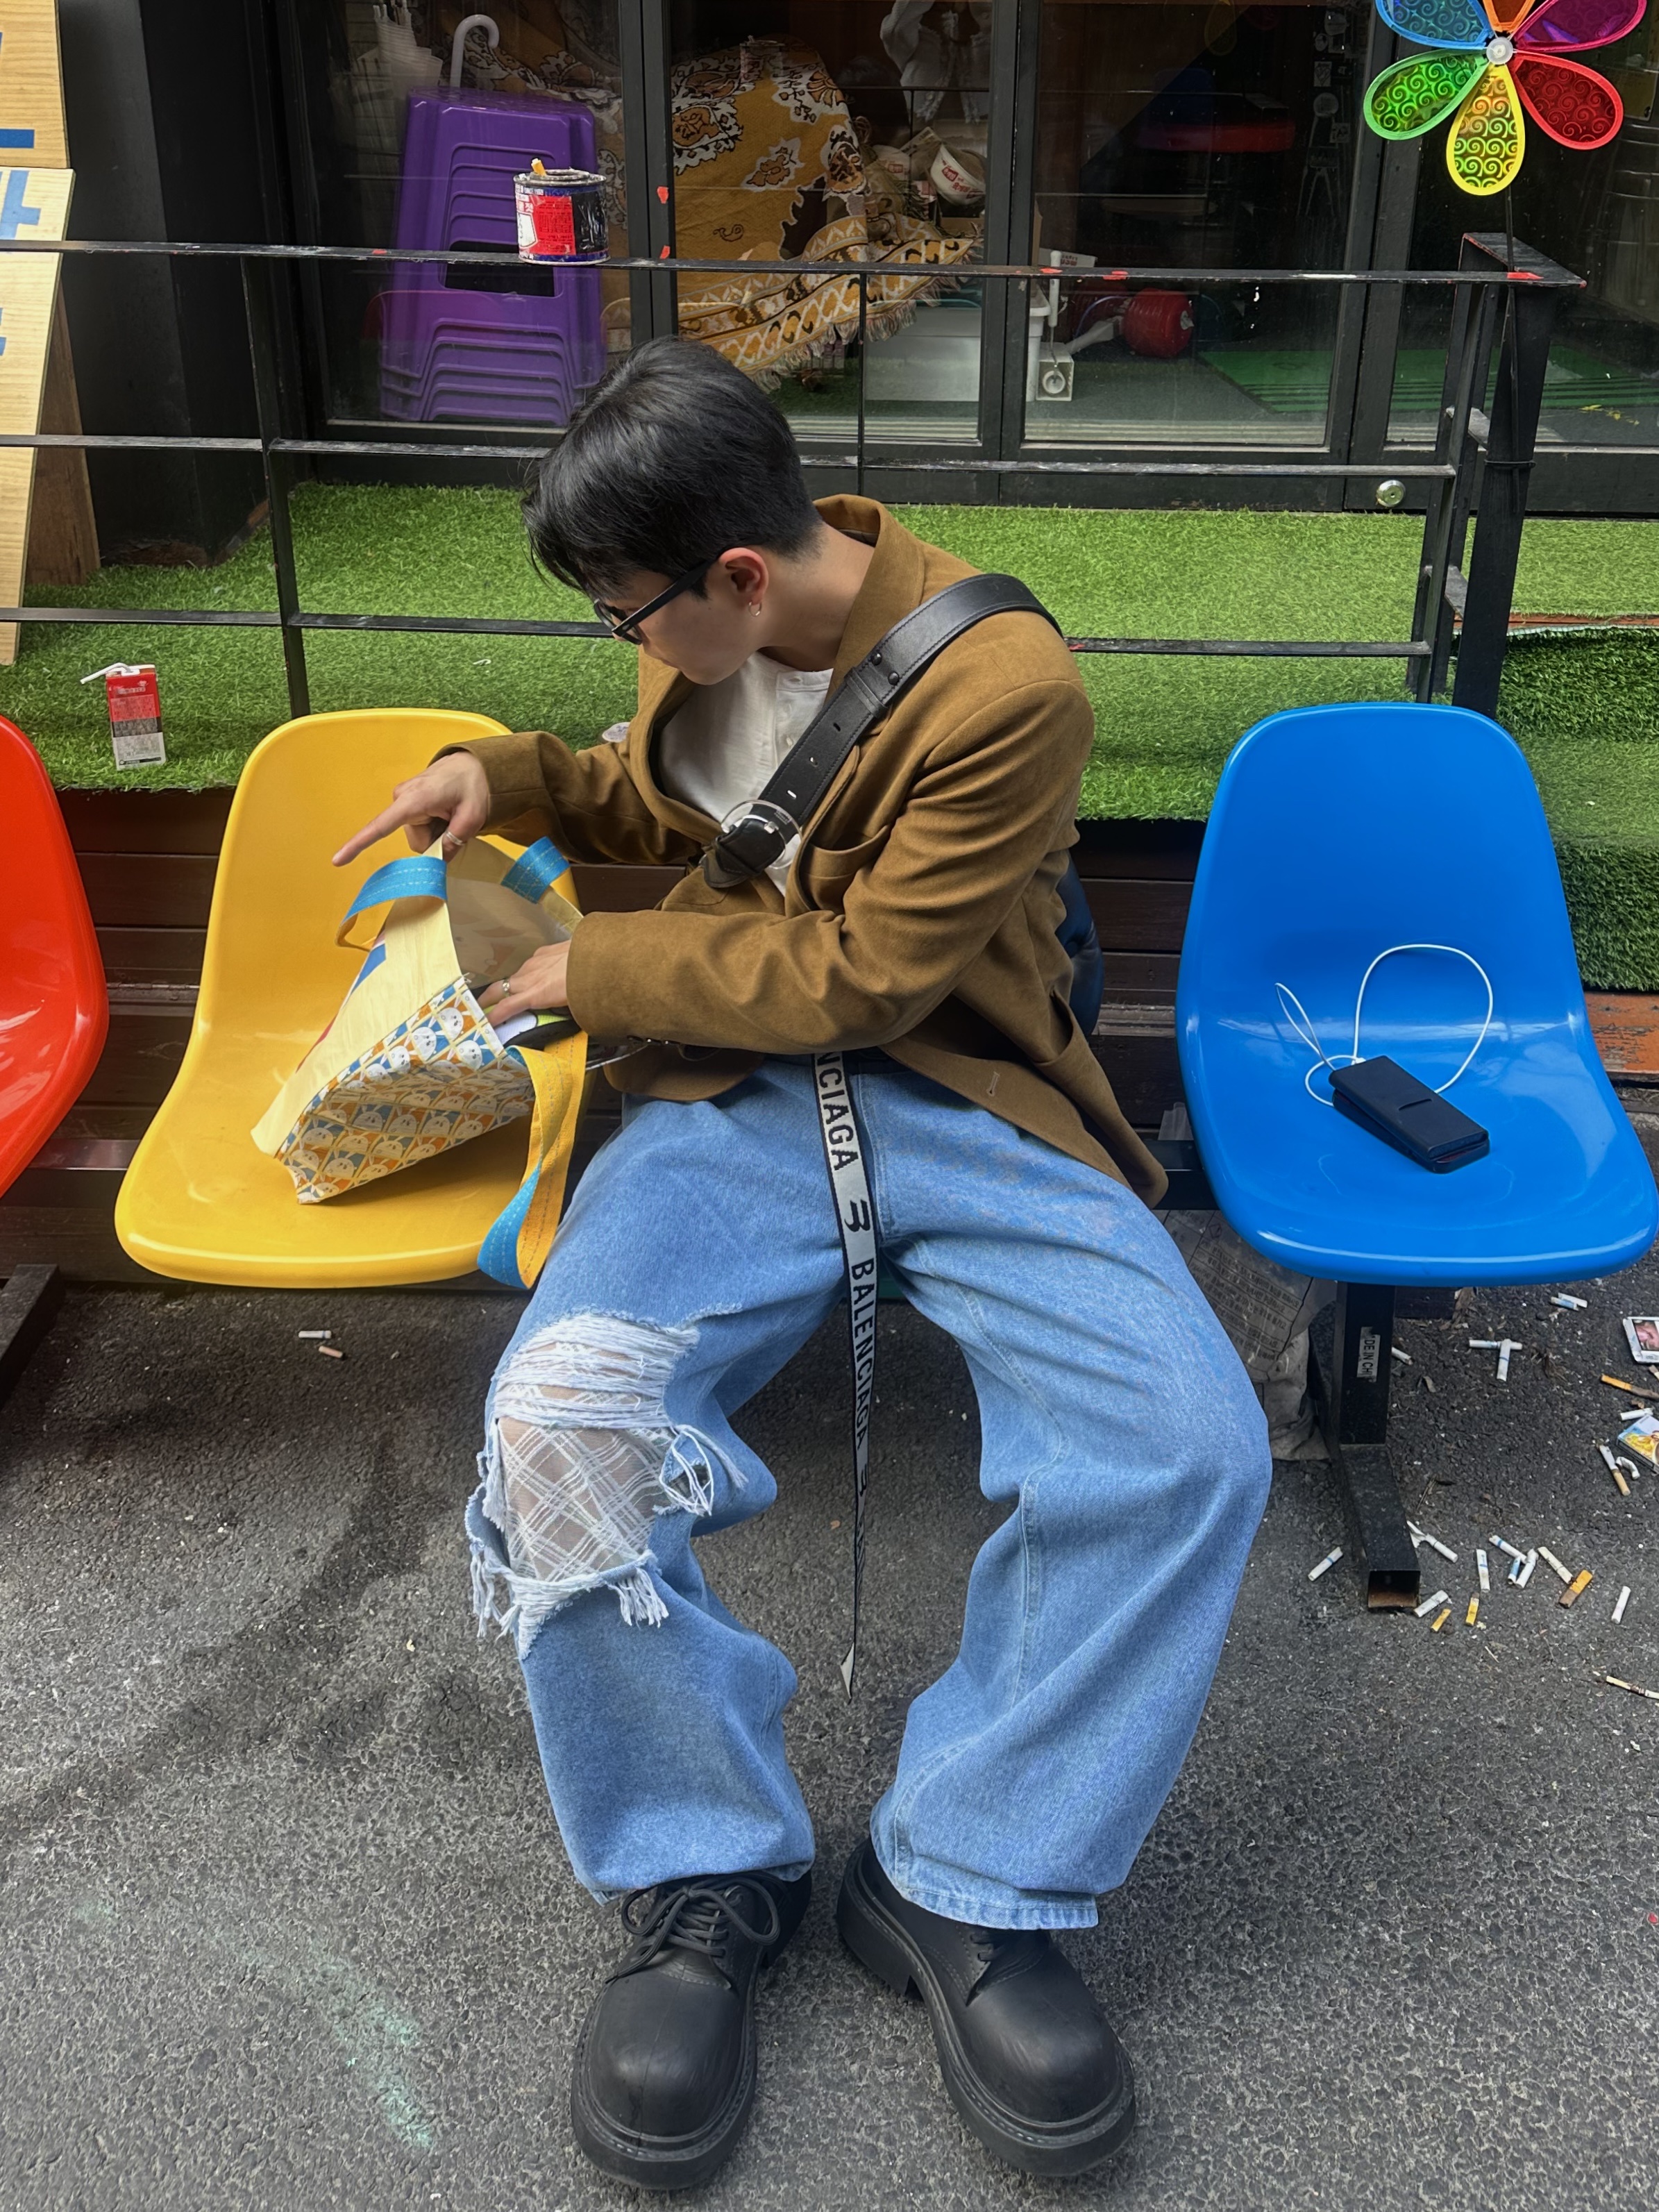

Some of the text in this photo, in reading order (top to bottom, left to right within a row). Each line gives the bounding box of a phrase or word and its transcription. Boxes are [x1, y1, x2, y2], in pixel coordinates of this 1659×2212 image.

[1364, 1336, 1375, 1350] DE
[852, 1257, 875, 1450] BALENCIAGA
[1363, 1352, 1374, 1360] IN
